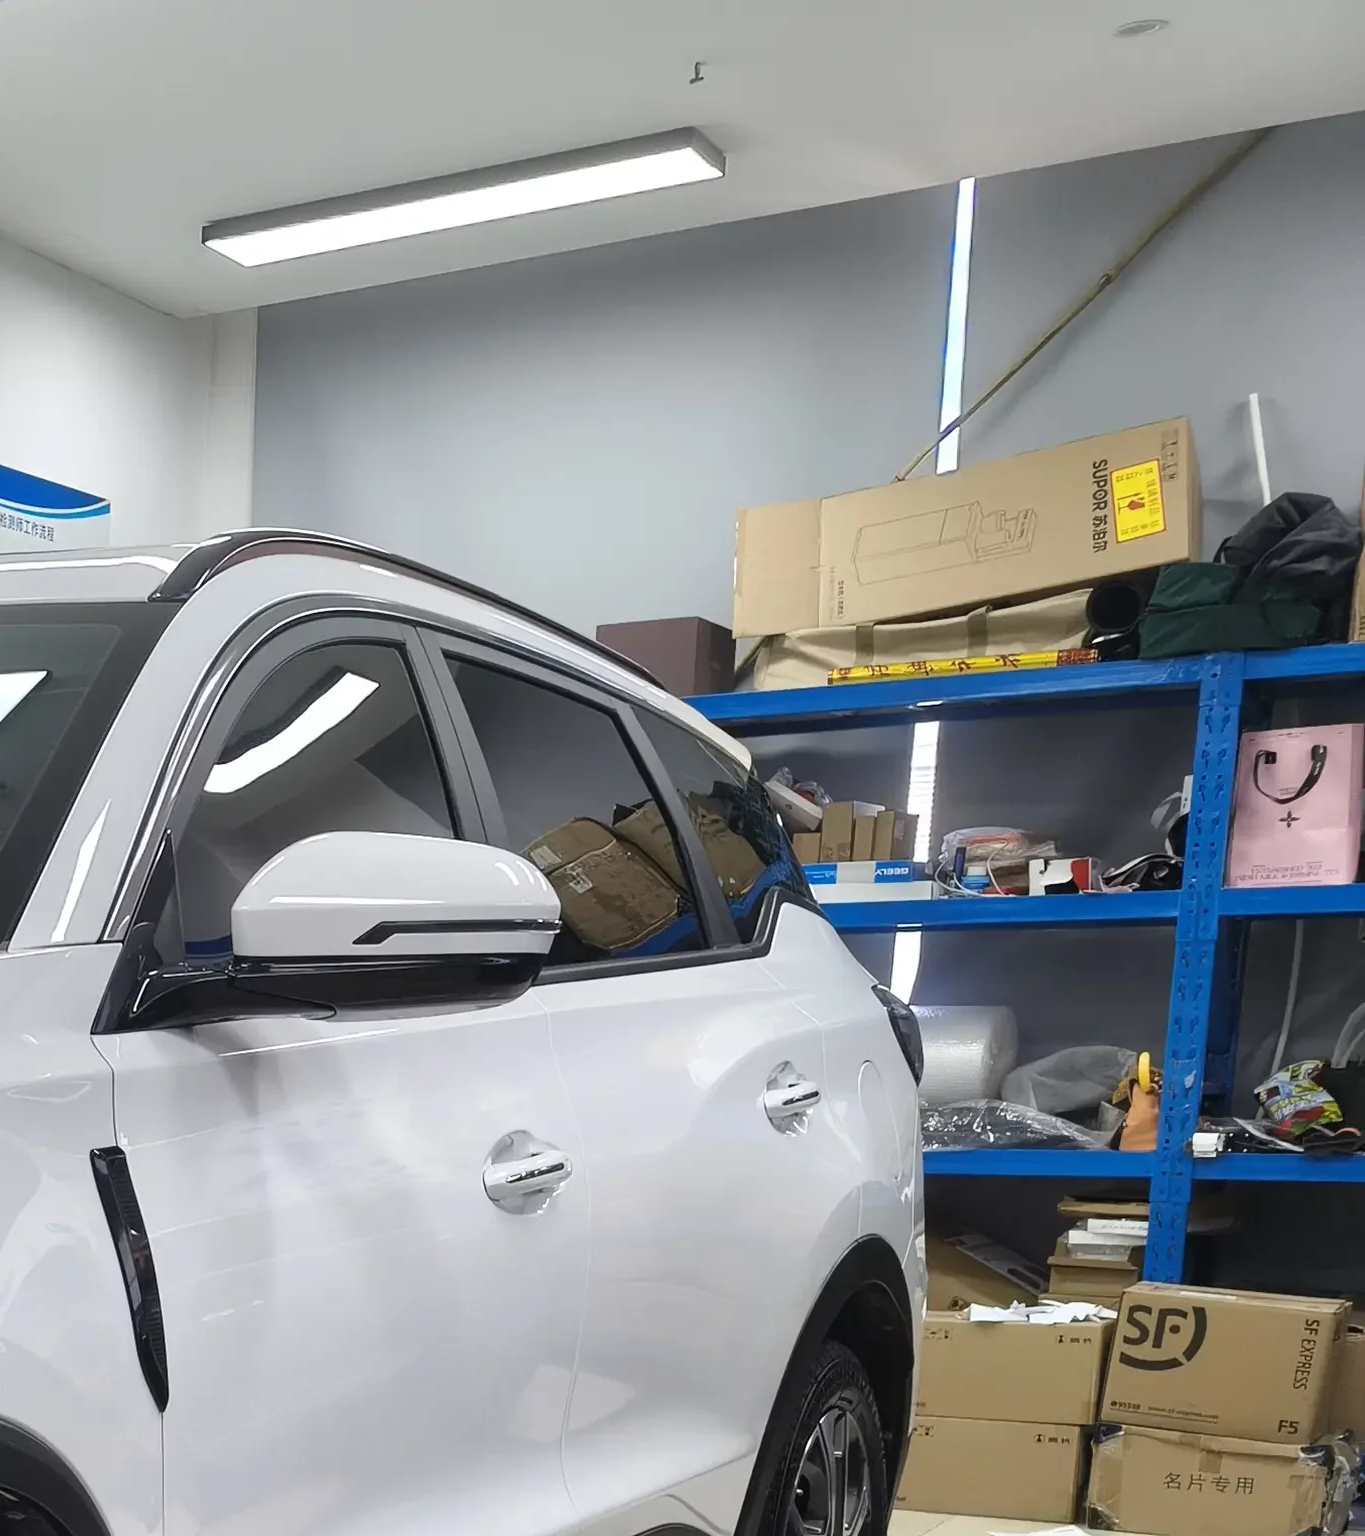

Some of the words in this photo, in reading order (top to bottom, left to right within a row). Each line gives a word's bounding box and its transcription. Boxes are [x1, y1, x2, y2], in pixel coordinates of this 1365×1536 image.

[1092, 459, 1108, 512] SUPOR
[0, 511, 55, 543] 检测师工作流程
[1092, 514, 1108, 554] 苏泊尔
[874, 867, 910, 876] GEELY
[1303, 1318, 1321, 1335] SF
[1293, 1338, 1317, 1391] EXPRESS
[1277, 1419, 1300, 1435] F5
[1163, 1472, 1255, 1494] 名片专用
